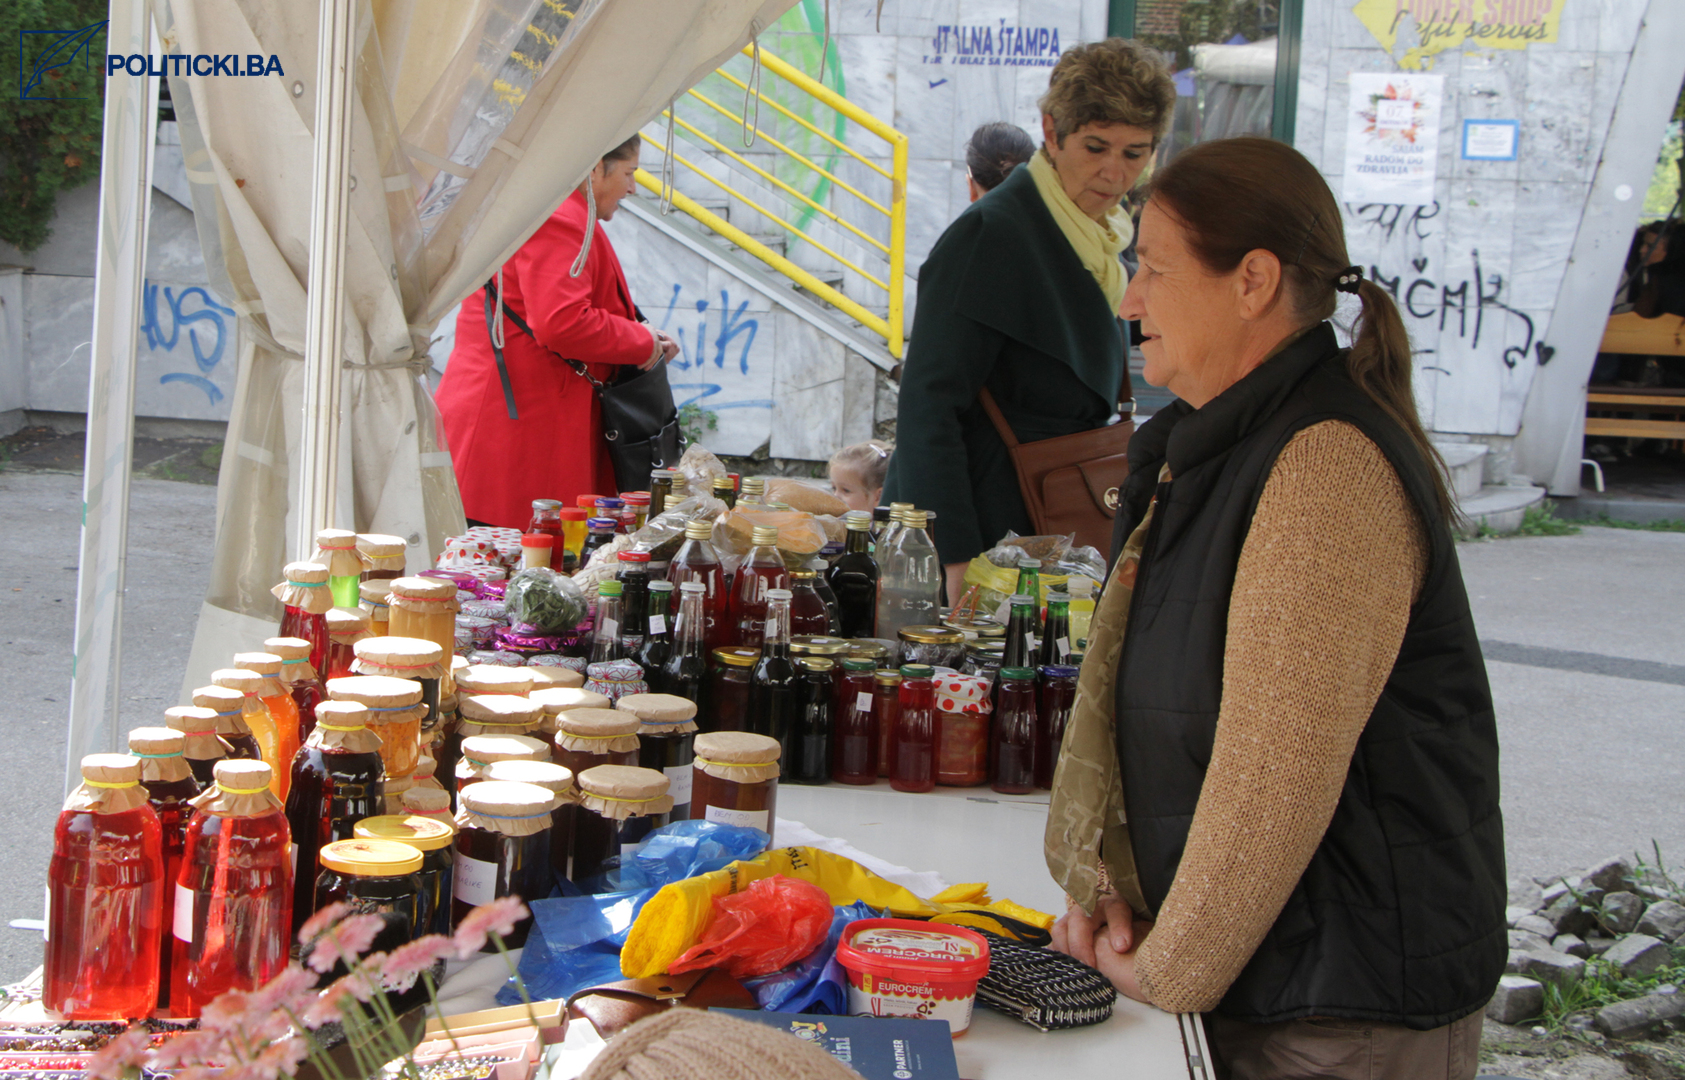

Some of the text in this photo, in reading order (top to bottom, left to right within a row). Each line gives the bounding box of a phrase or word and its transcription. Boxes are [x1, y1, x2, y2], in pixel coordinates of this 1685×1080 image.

[998, 18, 1061, 57] ŠTAMPA
[1464, 19, 1549, 41] servis
[958, 56, 985, 66] ULAZ
[987, 57, 1001, 66] SA
[866, 946, 966, 962] EUROCREM
[878, 982, 933, 995] EUROCREM
[892, 1039, 908, 1071] PARTNER
